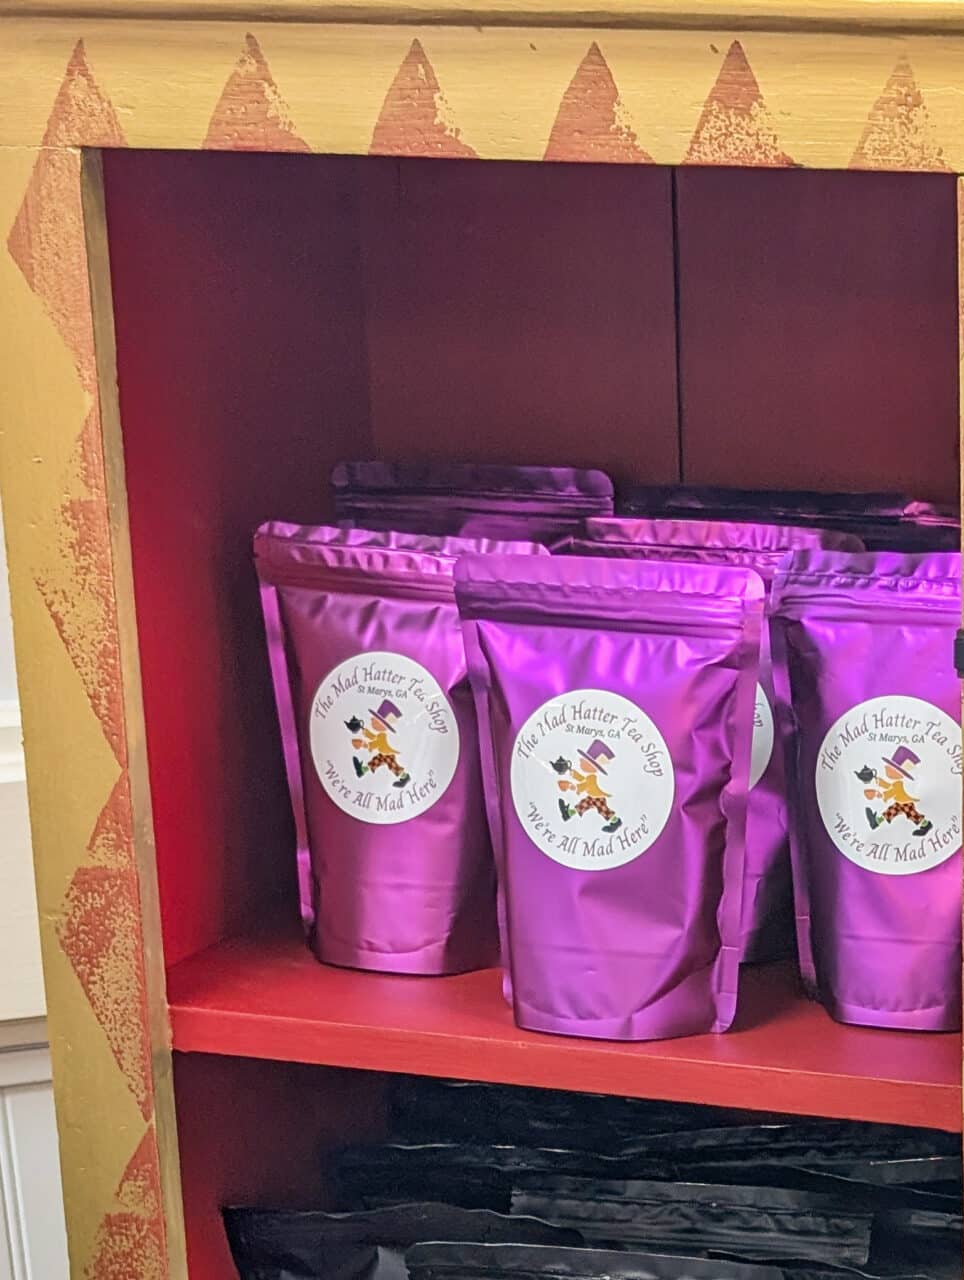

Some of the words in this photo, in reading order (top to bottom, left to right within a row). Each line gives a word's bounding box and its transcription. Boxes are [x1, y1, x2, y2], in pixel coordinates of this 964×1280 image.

[315, 696, 333, 719] The
[331, 666, 358, 698] Mad
[362, 662, 406, 684] Hatter
[426, 701, 448, 734] Shop
[357, 685, 365, 694] St
[396, 690, 407, 698] GA
[518, 734, 538, 759] The
[571, 700, 618, 724] Hatter
[622, 717, 642, 742] Tea
[641, 742, 664, 777] Shop
[565, 724, 574, 732] St
[608, 728, 620, 739] GA
[821, 743, 841, 771] The
[839, 716, 868, 749] Mad
[872, 708, 920, 730] Hatter
[925, 721, 948, 746] Tea
[867, 732, 877, 741] St
[911, 734, 925, 743] GA
[353, 792, 374, 808] All
[376, 794, 404, 811] Mad
[558, 836, 580, 854] All
[583, 835, 614, 857] Mad
[866, 843, 892, 862] All
[894, 844, 926, 862] Mad
